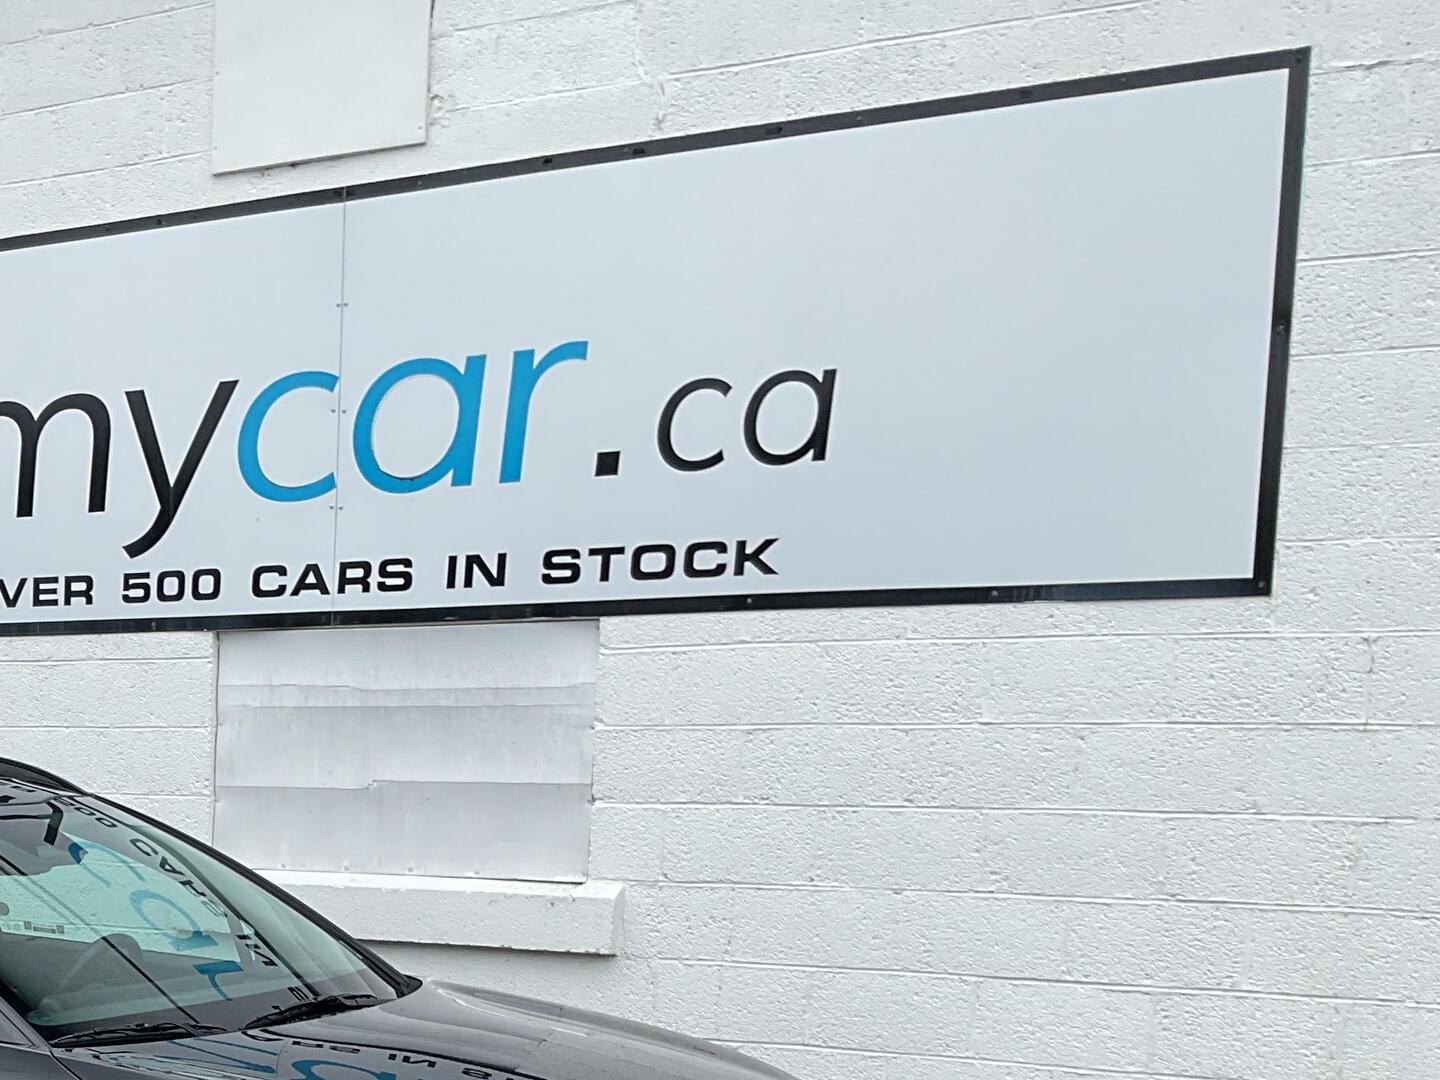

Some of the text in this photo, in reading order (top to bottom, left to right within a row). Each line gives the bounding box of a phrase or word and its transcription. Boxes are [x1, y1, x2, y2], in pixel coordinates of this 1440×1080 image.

[121, 568, 222, 604] 500
[251, 557, 413, 598] CARS
[446, 552, 508, 590] IN
[541, 537, 780, 585] STOCK
